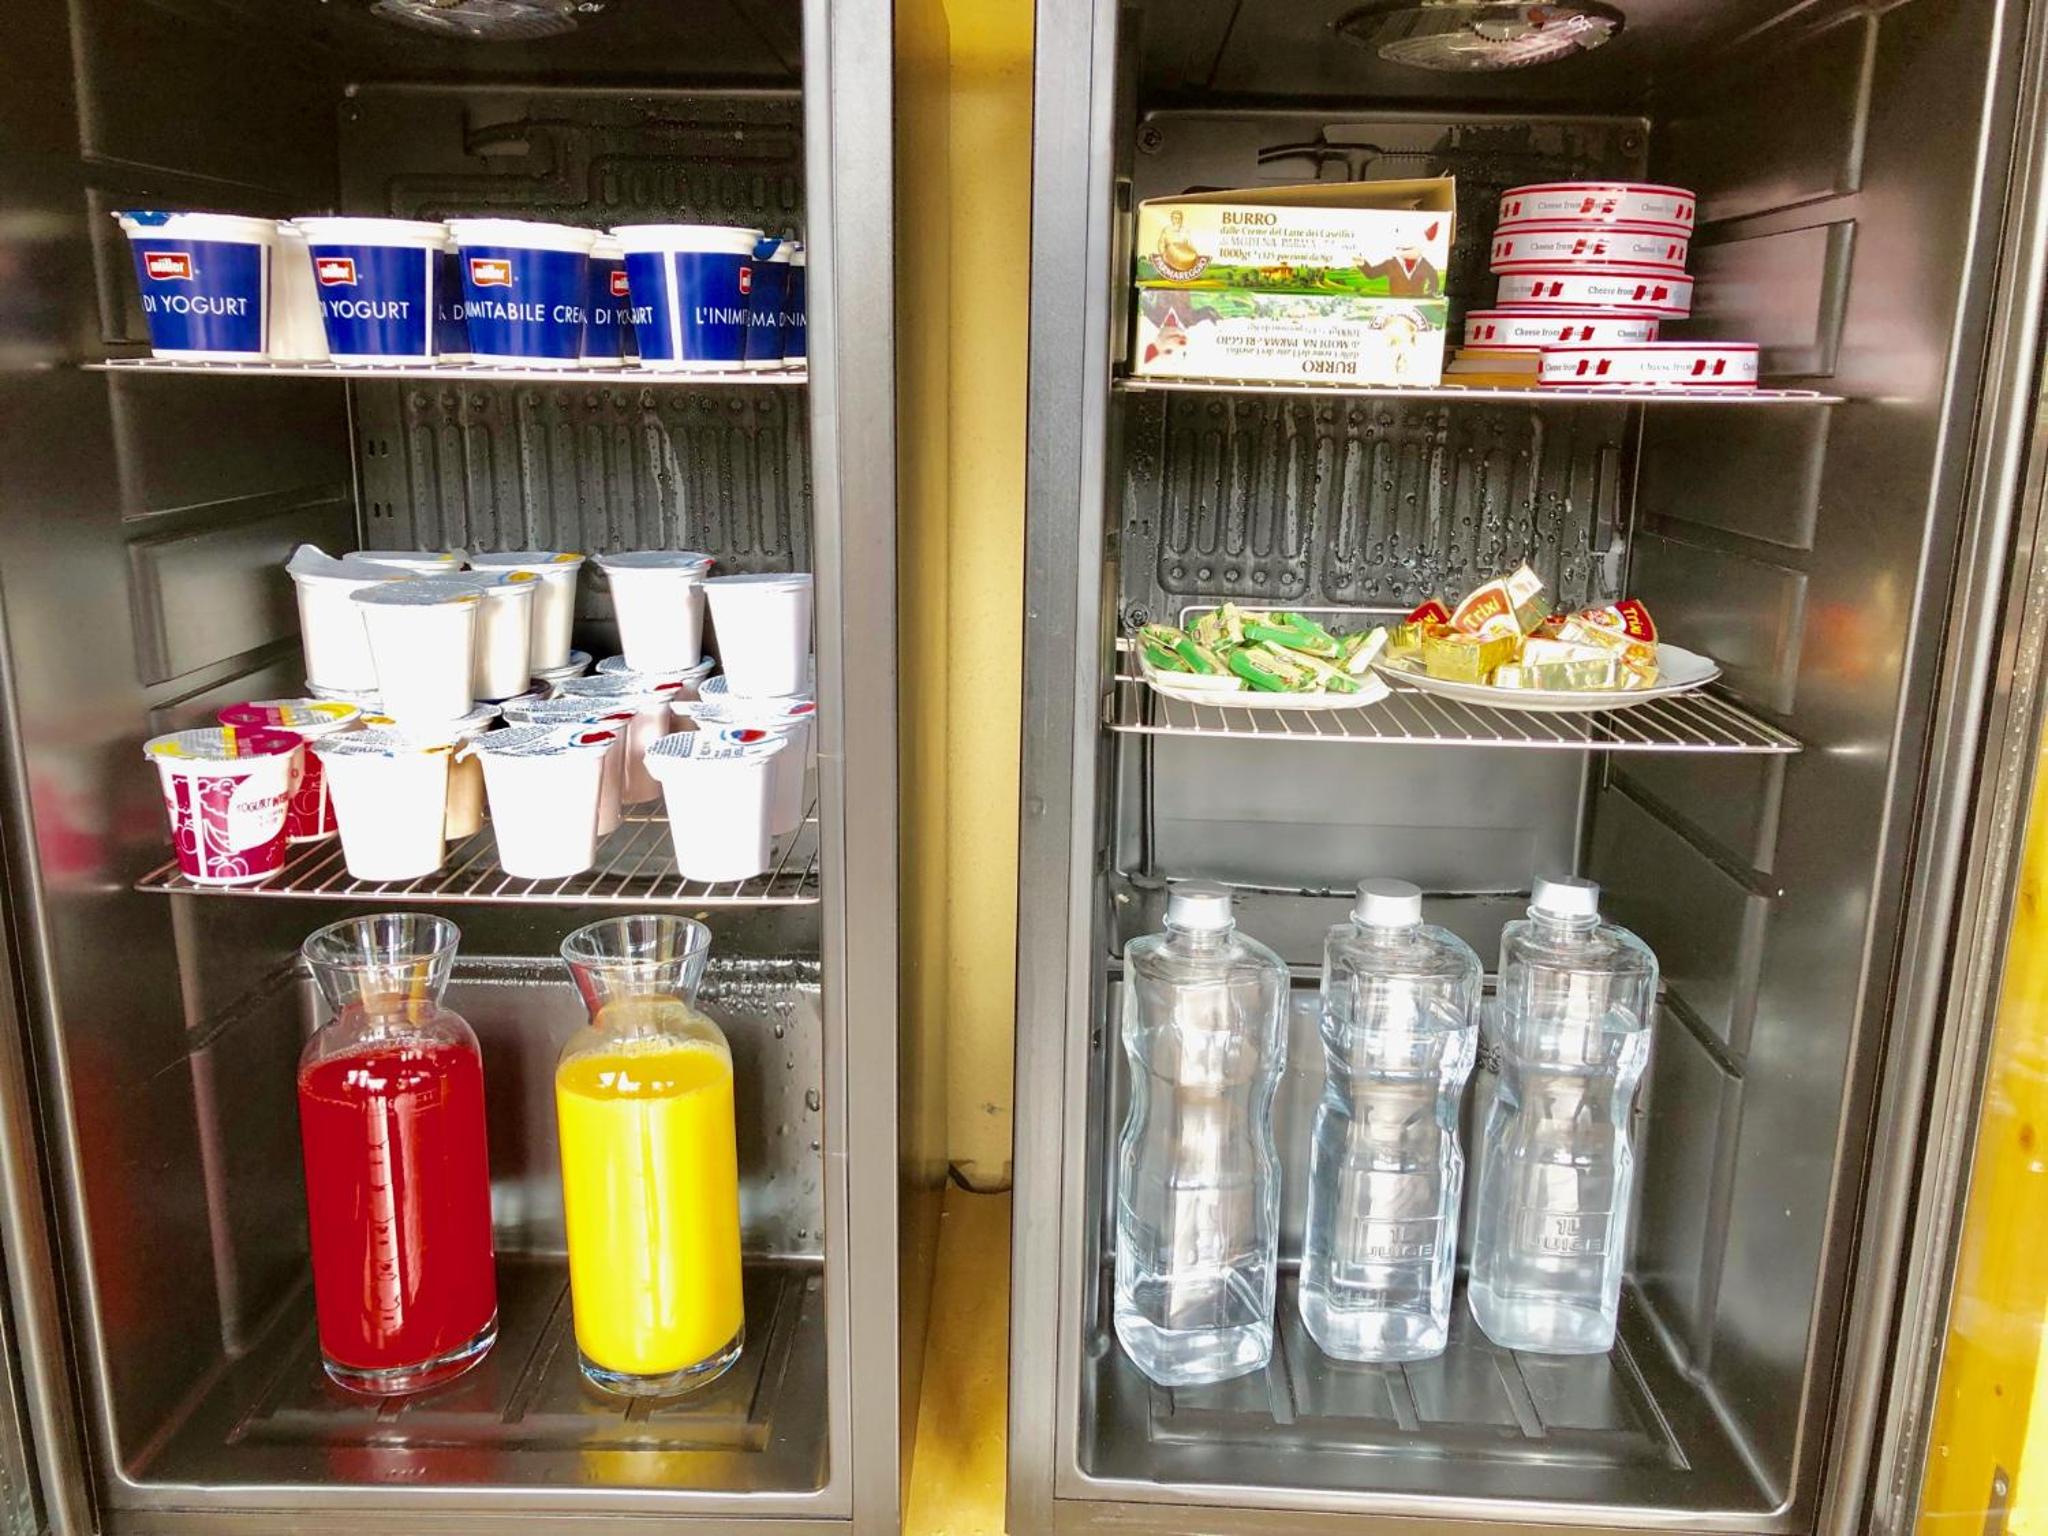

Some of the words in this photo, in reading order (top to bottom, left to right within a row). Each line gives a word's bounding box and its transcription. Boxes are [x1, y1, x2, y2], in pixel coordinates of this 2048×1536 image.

[1222, 211, 1278, 226] BURRO
[143, 295, 157, 313] DI
[161, 295, 248, 316] YOGURT
[330, 300, 410, 320] YOGURT
[595, 308, 611, 325] DI
[1514, 327, 1540, 336] Cheese
[1302, 359, 1357, 374] BURRO
[1556, 1217, 1581, 1235] 1L
